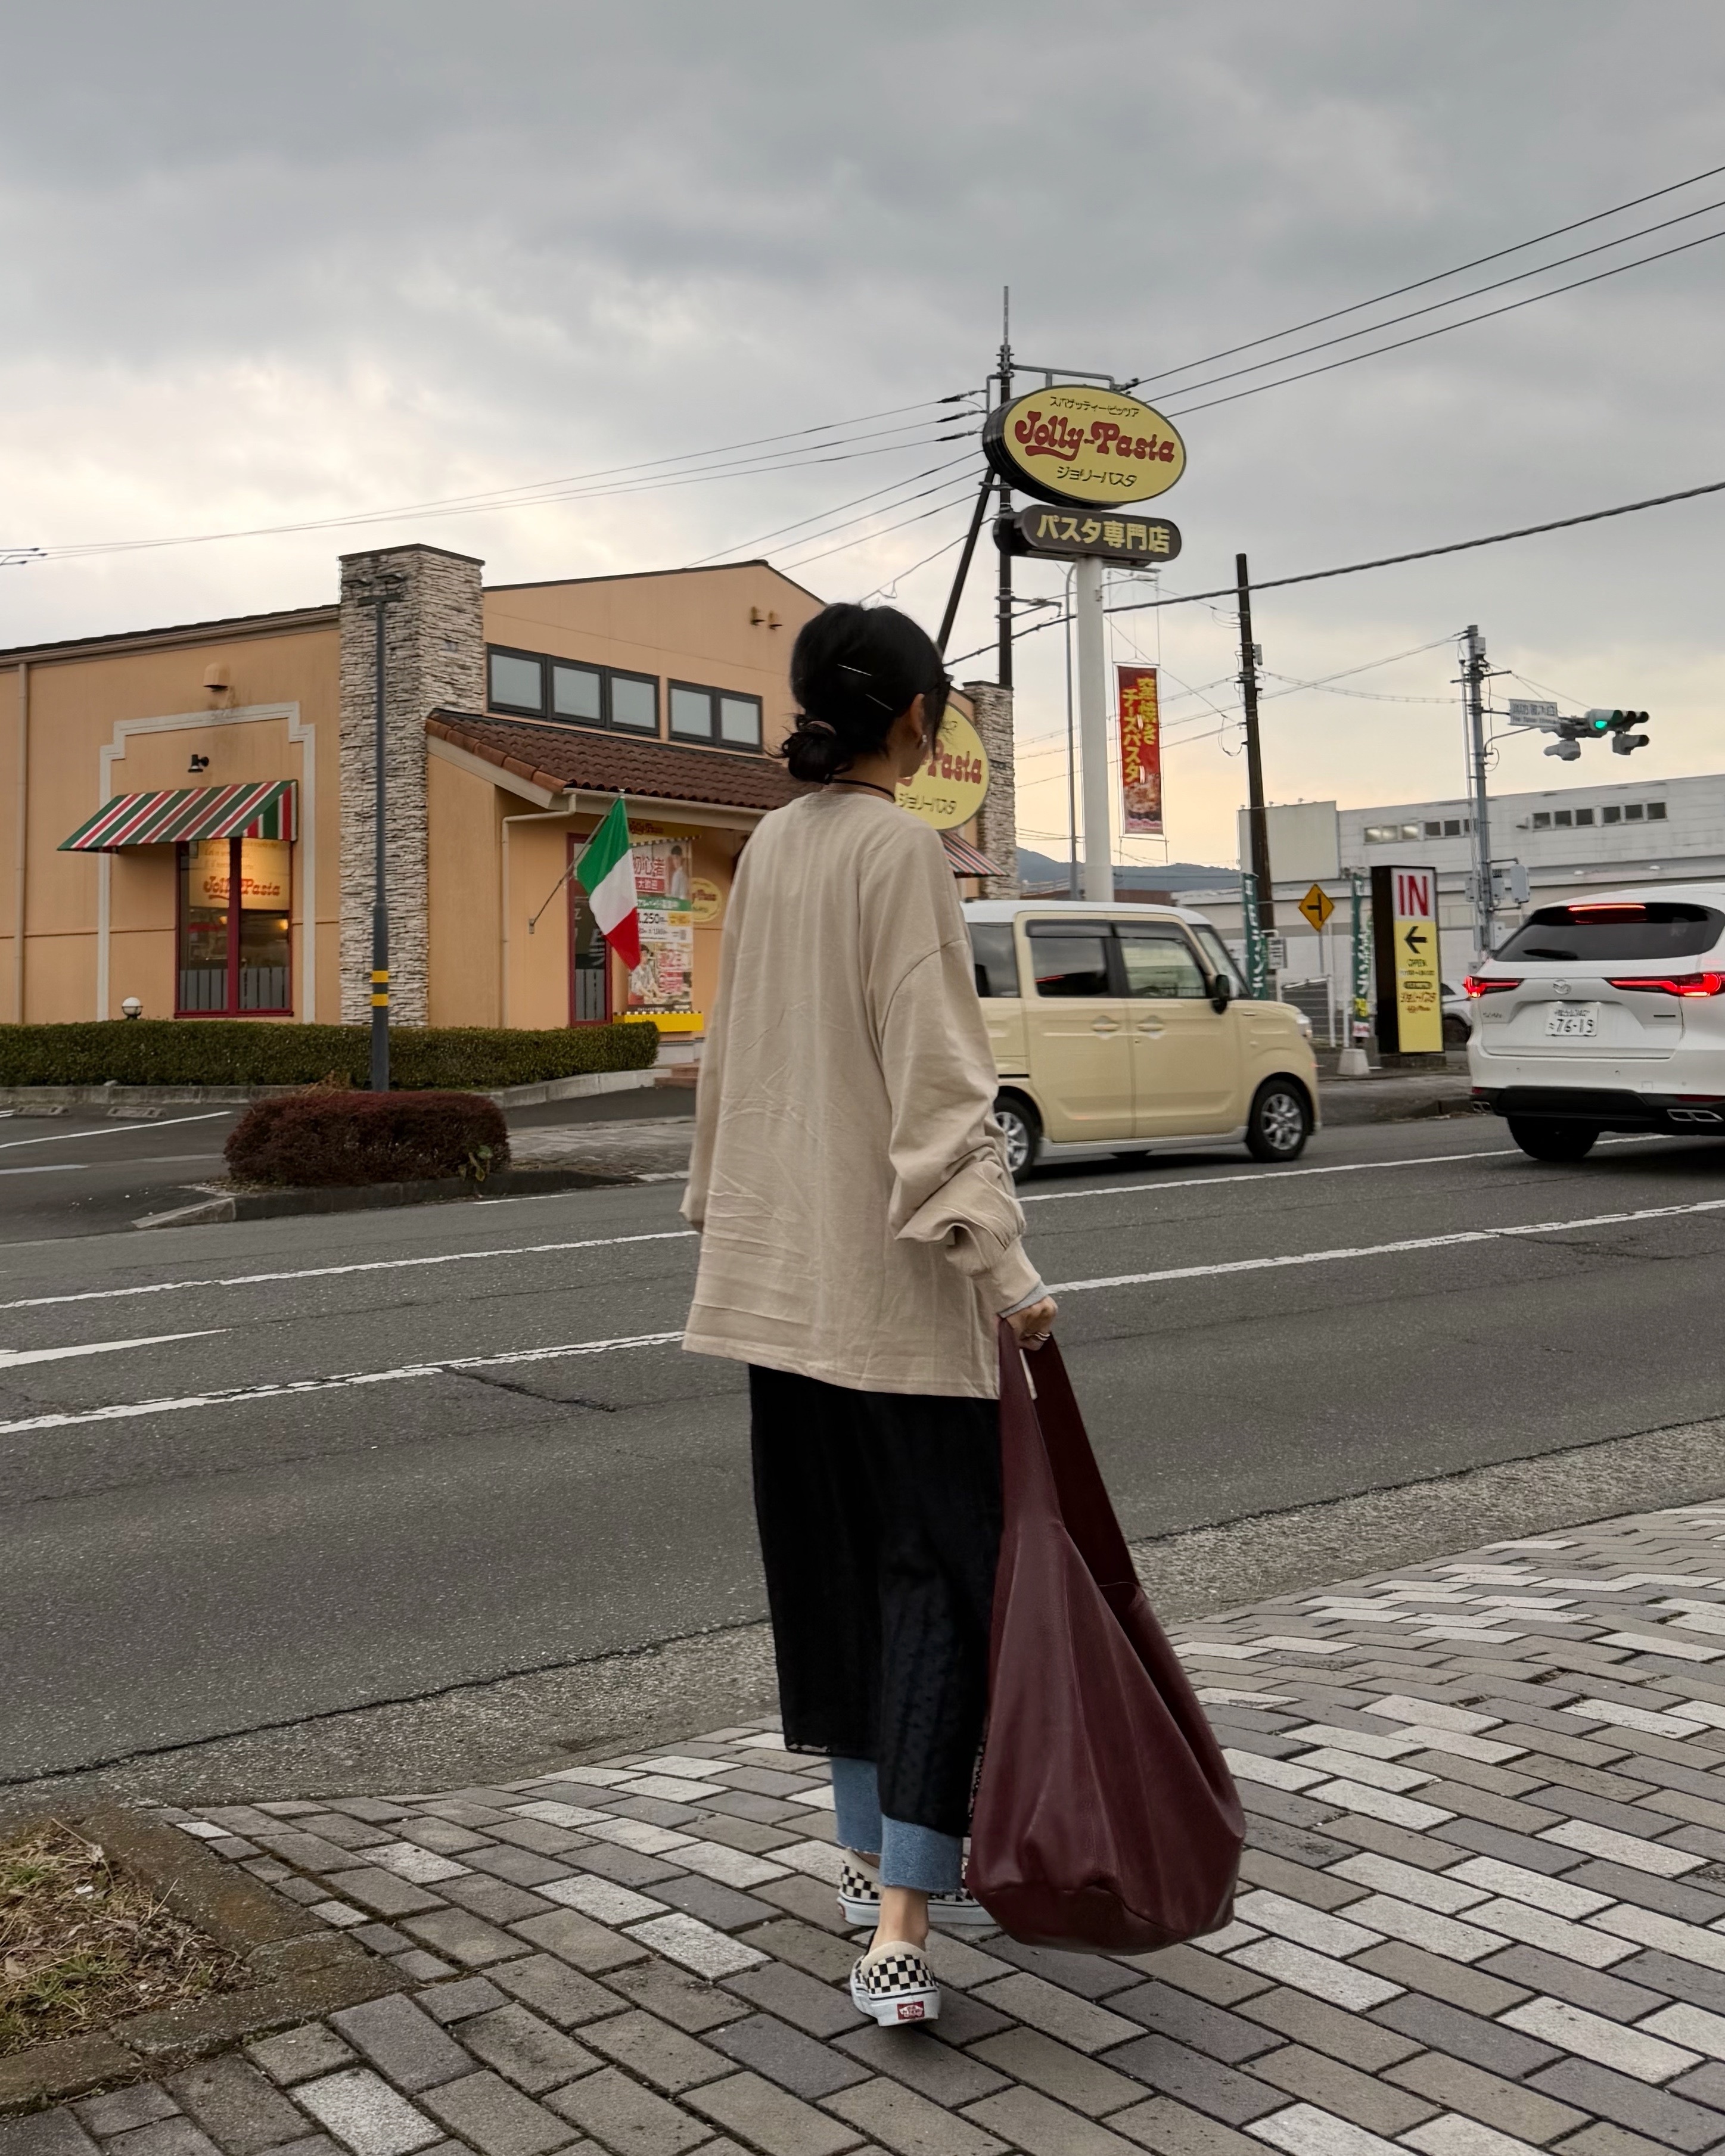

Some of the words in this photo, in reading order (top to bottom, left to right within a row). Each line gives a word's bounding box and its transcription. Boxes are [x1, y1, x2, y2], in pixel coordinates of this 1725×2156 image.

[1015, 410, 1175, 463] Jolly-Pasta
[1057, 466, 1137, 487] ジョリーパスタ
[1037, 515, 1170, 554] パスタ専門店
[203, 876, 281, 900] JollPasta
[1398, 875, 1430, 916] IN
